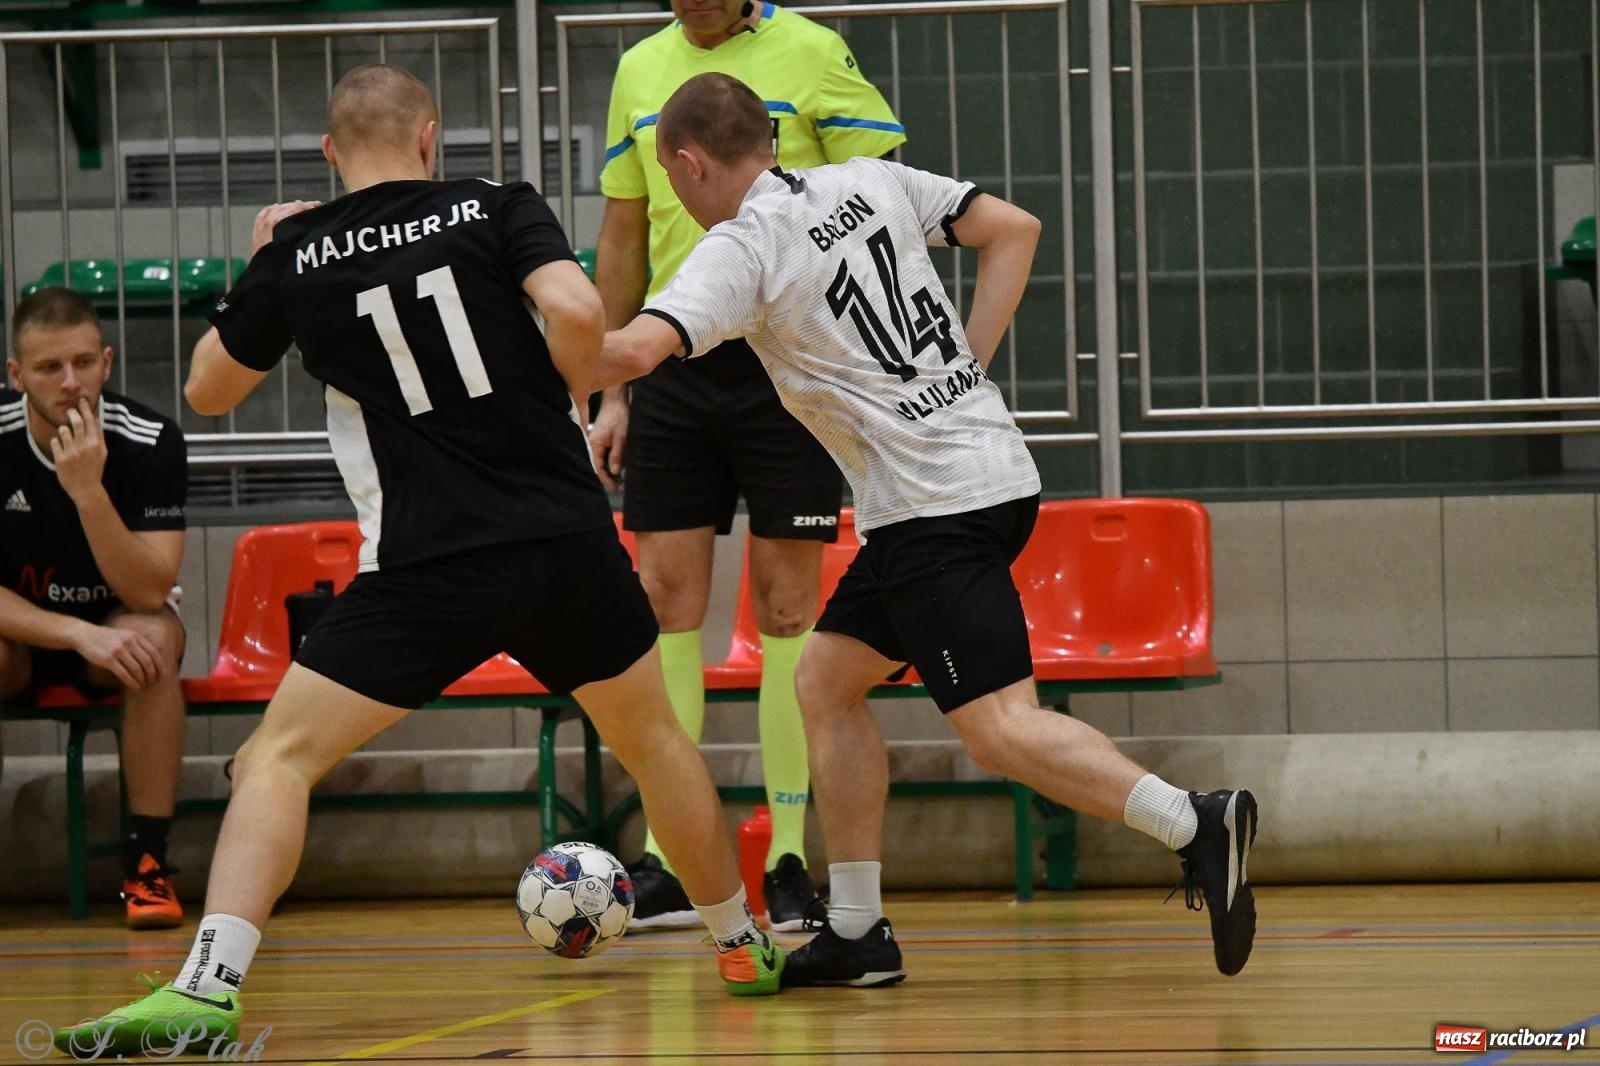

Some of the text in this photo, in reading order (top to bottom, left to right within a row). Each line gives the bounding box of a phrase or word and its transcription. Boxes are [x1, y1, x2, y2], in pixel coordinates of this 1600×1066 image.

[296, 199, 489, 274] MAJCHER JR.
[825, 225, 961, 384] 14
[356, 265, 493, 417] 11
[793, 515, 837, 527] zina
[18, 564, 119, 602] Nexan
[942, 649, 959, 685] KIPSTA
[775, 791, 809, 805] zin
